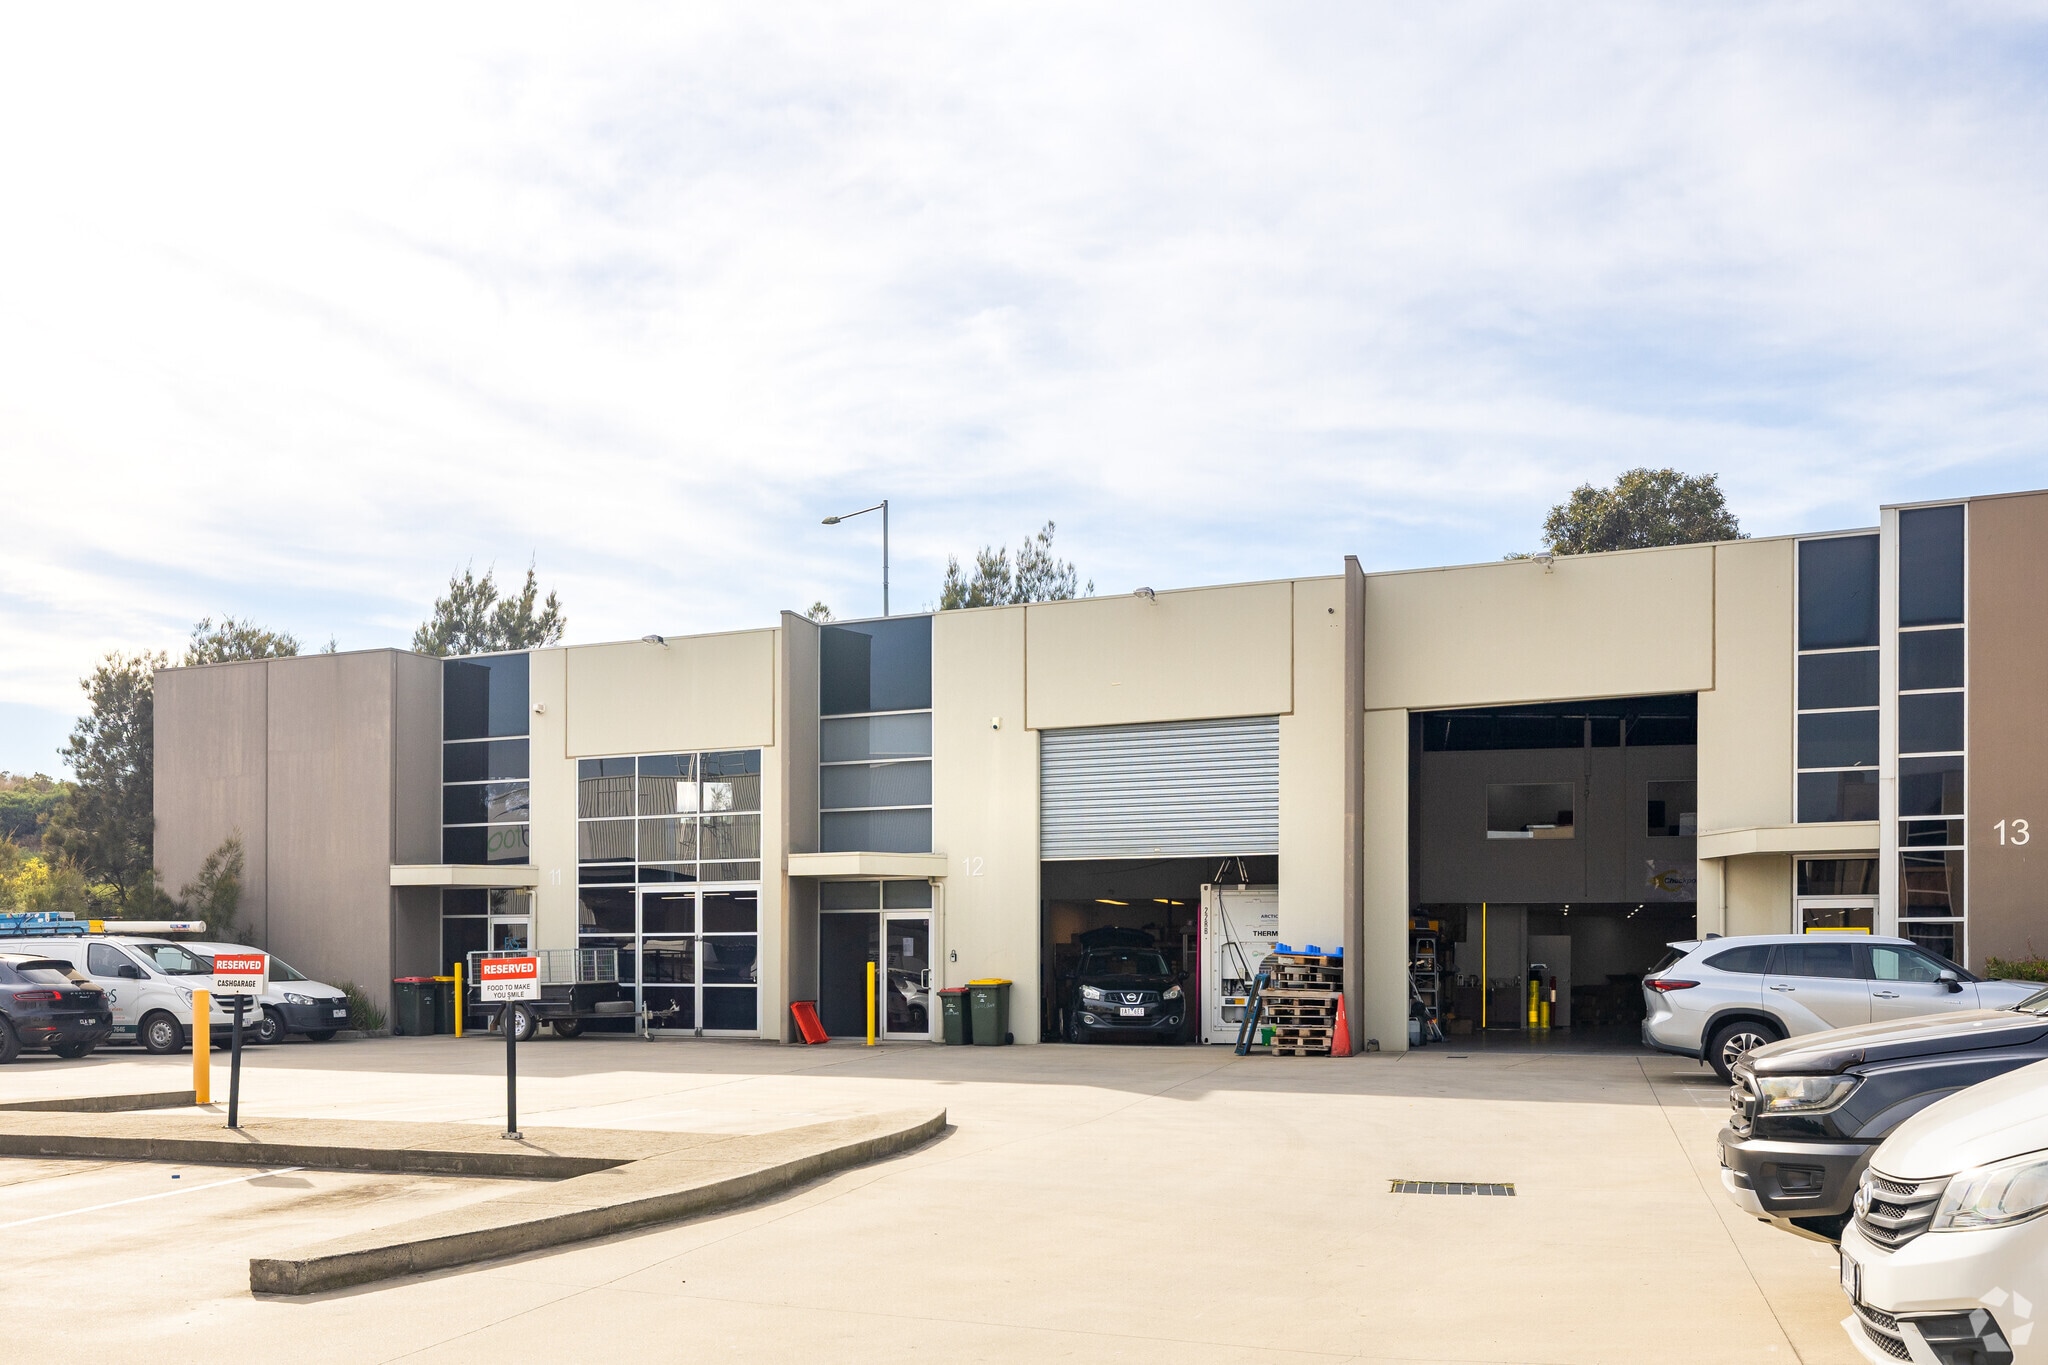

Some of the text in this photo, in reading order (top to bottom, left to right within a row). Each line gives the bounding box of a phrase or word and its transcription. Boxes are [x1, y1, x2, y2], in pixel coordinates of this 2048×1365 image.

[1993, 818, 2030, 846] 13
[962, 857, 984, 876] 12
[549, 868, 561, 886] 11
[216, 960, 262, 970] RESERVED
[483, 963, 534, 975] RESERVED
[217, 979, 257, 988] CASHGARAGE
